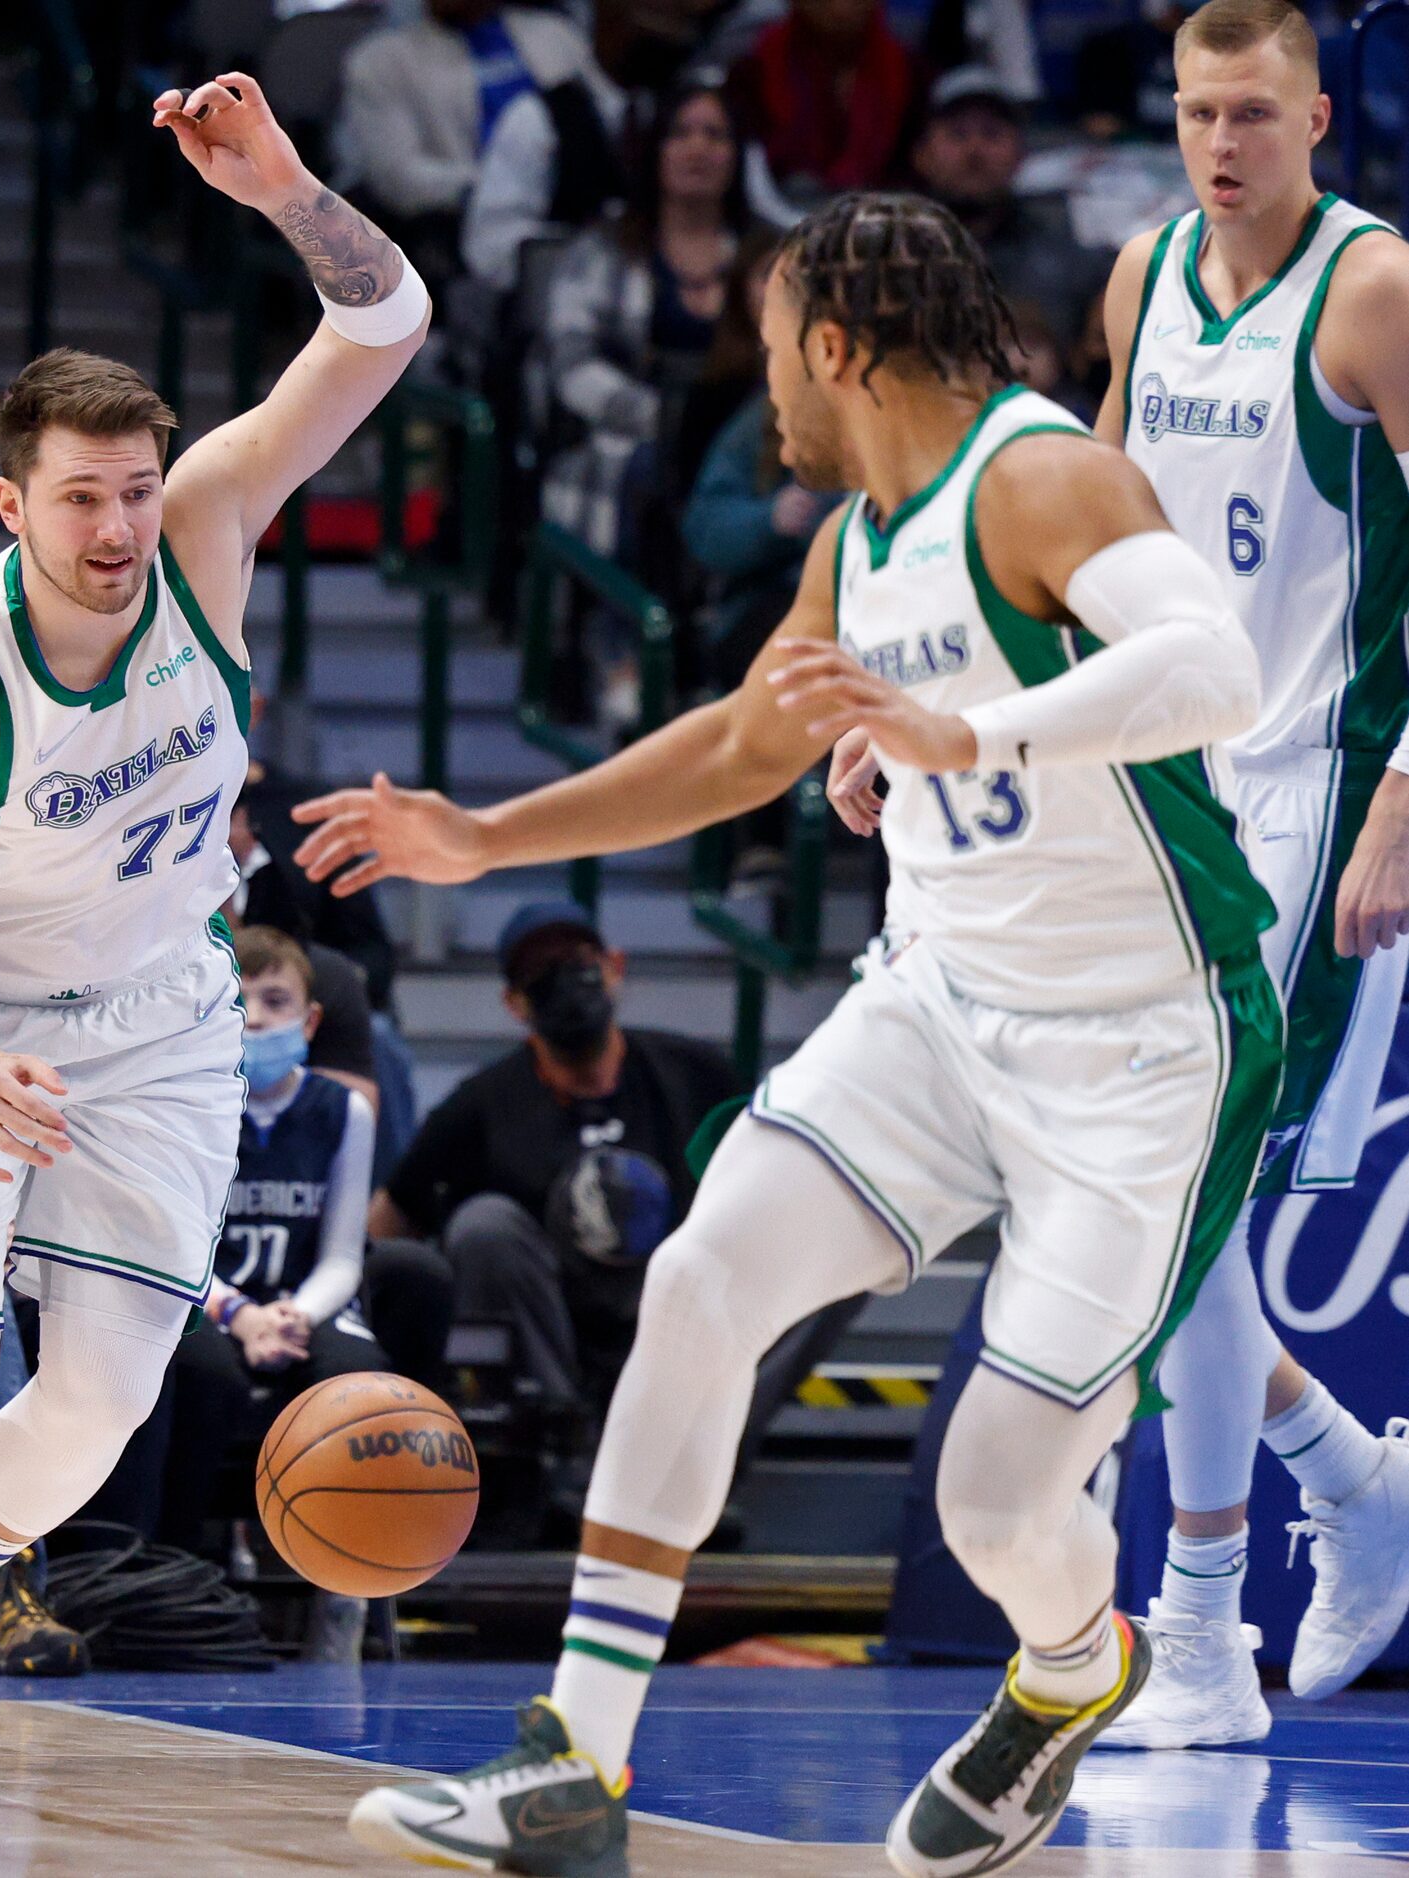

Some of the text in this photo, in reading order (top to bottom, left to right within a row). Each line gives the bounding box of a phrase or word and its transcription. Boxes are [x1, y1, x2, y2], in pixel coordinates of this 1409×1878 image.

[1236, 330, 1281, 351] chime
[1139, 384, 1272, 441] DALLAS
[1226, 491, 1266, 577] 6
[145, 645, 197, 688] chime
[29, 704, 219, 829] DALLAS
[117, 782, 224, 882] 77
[226, 1223, 291, 1288] 77
[347, 1428, 475, 1475] Wilson
